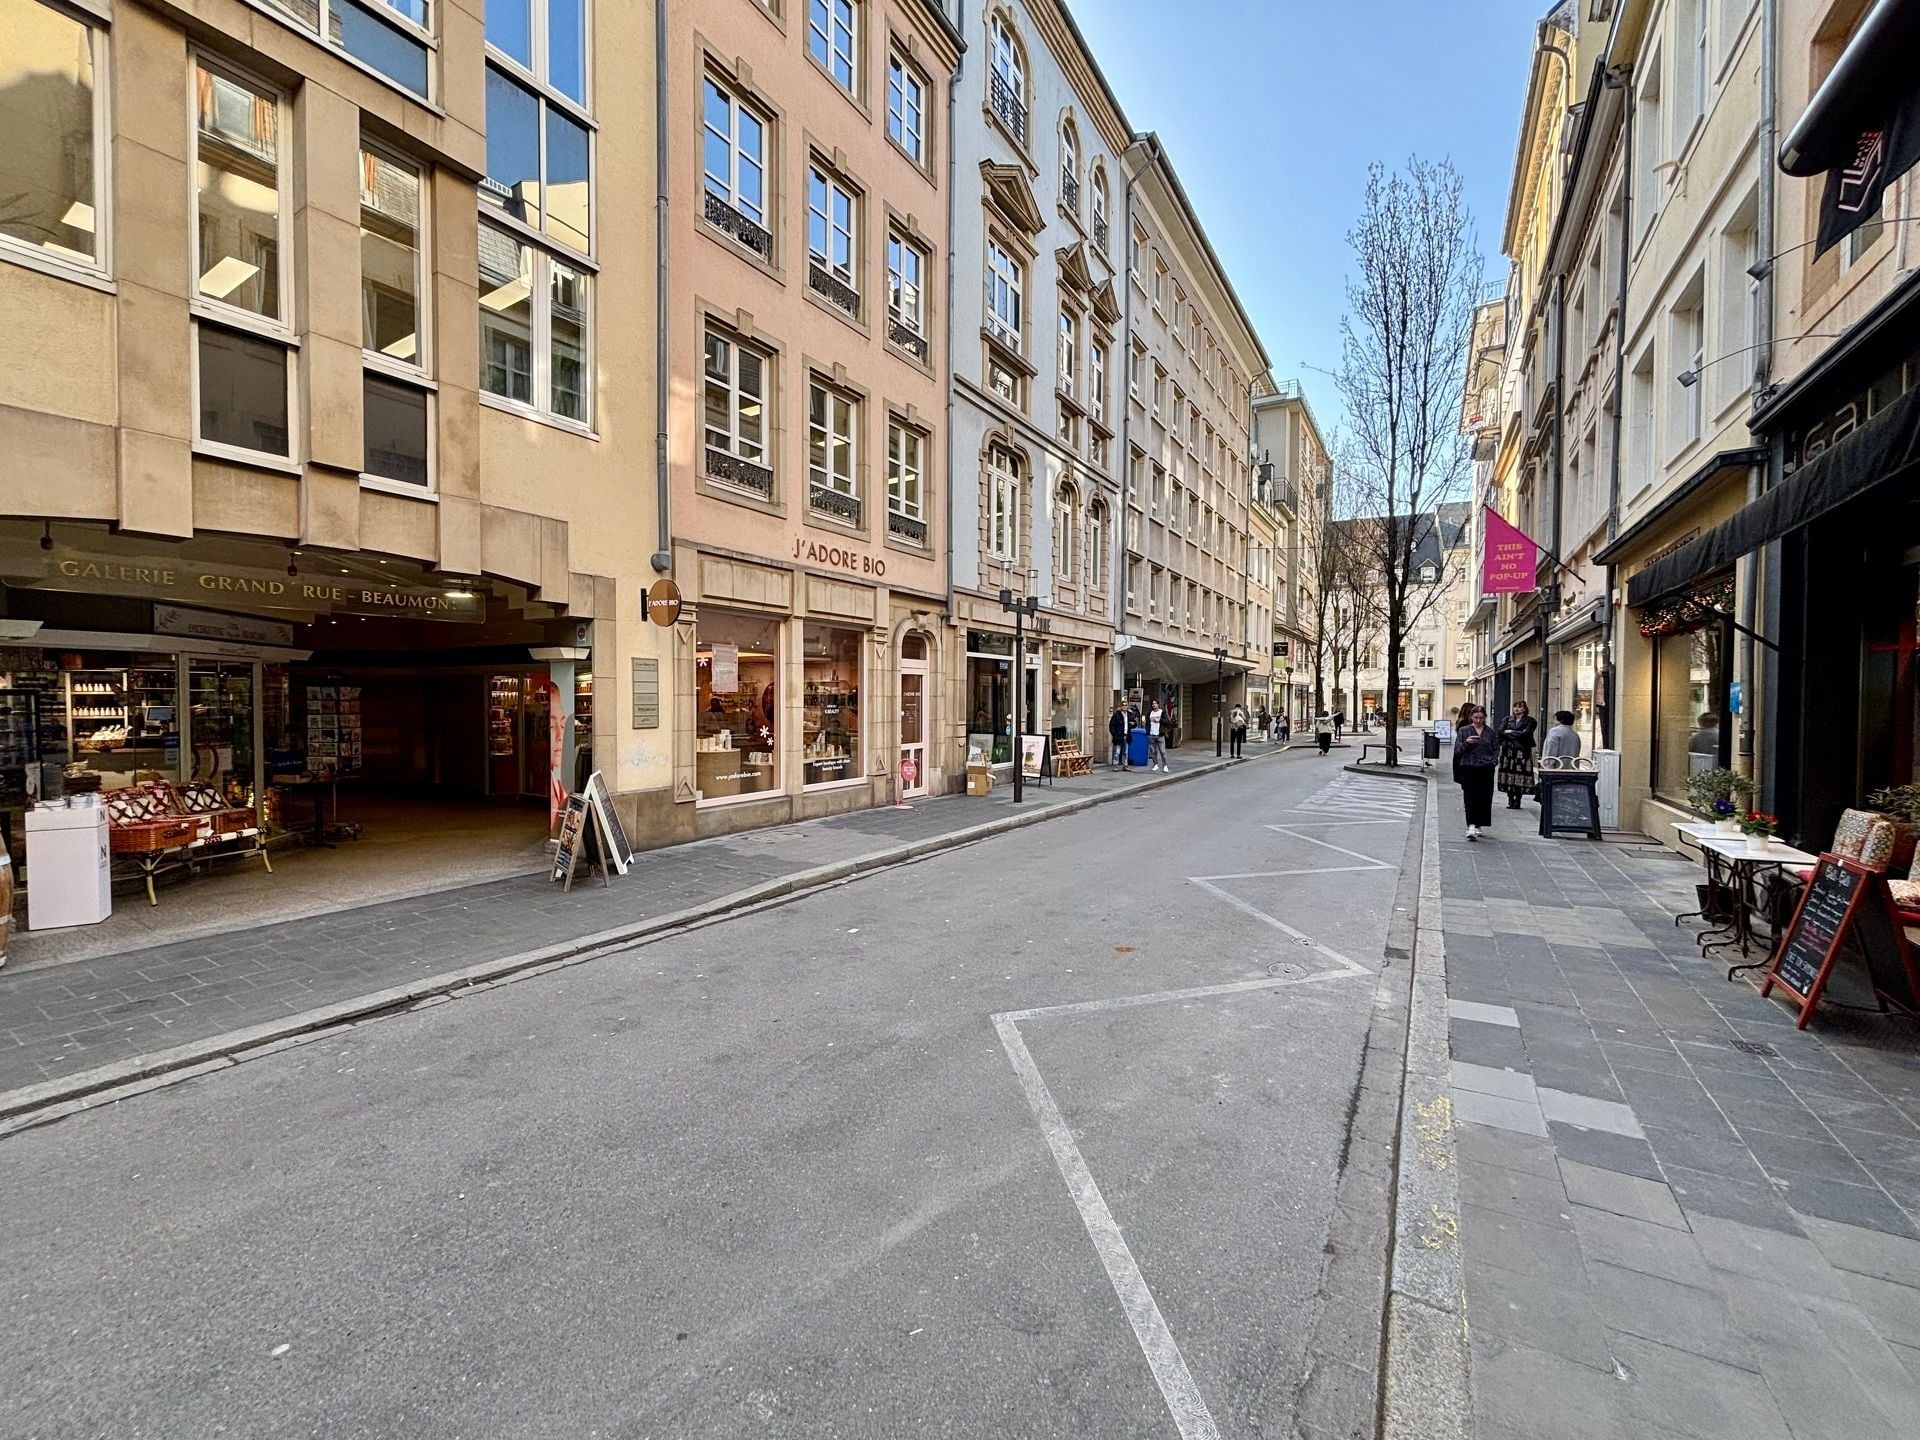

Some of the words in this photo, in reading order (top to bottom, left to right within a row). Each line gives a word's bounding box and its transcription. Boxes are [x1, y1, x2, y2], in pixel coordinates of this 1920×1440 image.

[793, 538, 857, 569] J'ADORE
[863, 555, 886, 577] BIO
[59, 560, 176, 585] GALERIE
[199, 574, 285, 595] GRAND
[303, 585, 342, 601] RUE
[361, 590, 459, 611] BEAUMON
[1490, 572, 1528, 580] POP-UP
[100, 843, 107, 861] N
